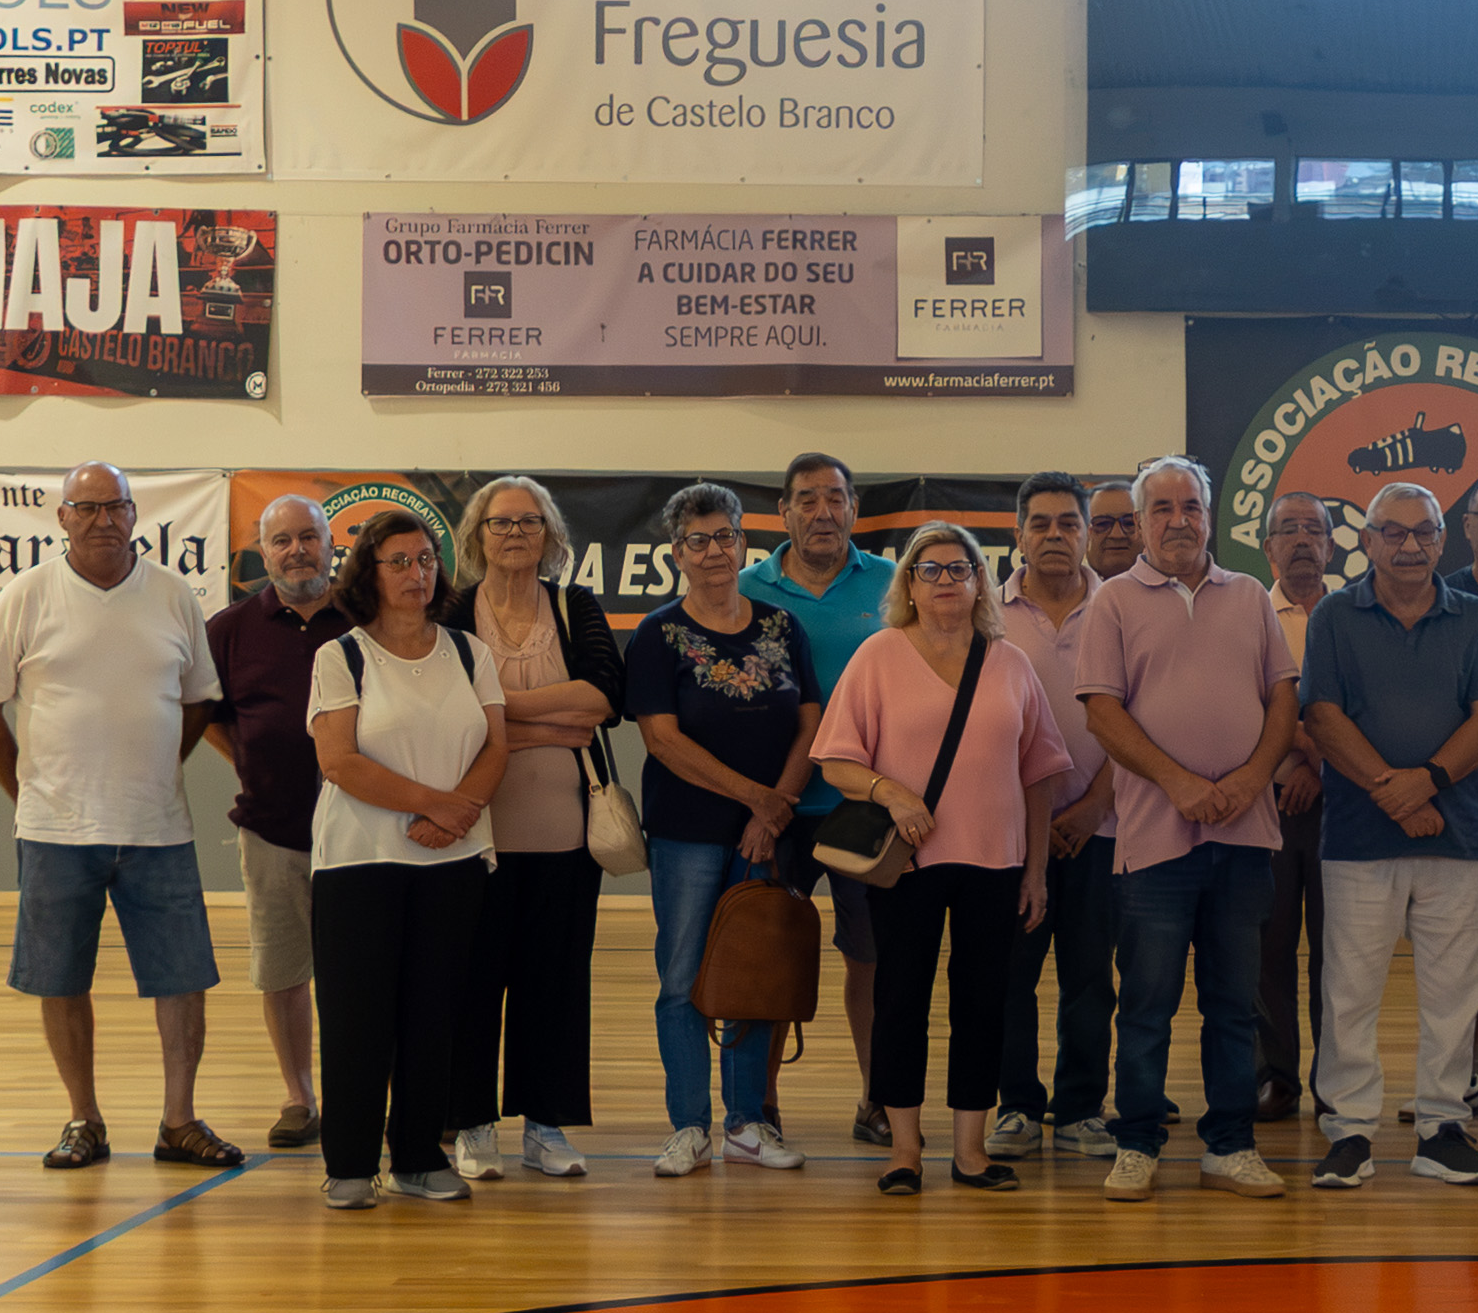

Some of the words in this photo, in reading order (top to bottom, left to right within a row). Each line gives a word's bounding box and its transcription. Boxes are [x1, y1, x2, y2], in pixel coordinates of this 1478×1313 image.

[161, 3, 210, 14] NEW
[146, 41, 202, 53] TOPTUL
[595, 0, 925, 86] Freguesia
[46, 62, 107, 85] Novas
[30, 102, 73, 113] codex
[595, 96, 635, 128] de
[646, 96, 766, 128] Castelo
[779, 97, 895, 130] Branco
[634, 224, 755, 252] FARMÁCIA
[761, 229, 858, 252] FERRER
[383, 240, 594, 266] ORTO-PEDICIN
[638, 263, 654, 283] A
[663, 262, 756, 283] CUIDAR
[764, 262, 798, 283] DO
[806, 262, 855, 283] SEU
[676, 295, 816, 316] BEM-ESTAR
[914, 298, 1026, 318] FERRER
[434, 327, 542, 345] FERRER
[884, 373, 1055, 389] www.farmaciaferrer.pt
[1230, 341, 1421, 550] ASSOCIAÇÃO
[324, 486, 378, 516] OCIAÇÃO
[382, 487, 445, 538] RECREATIVA
